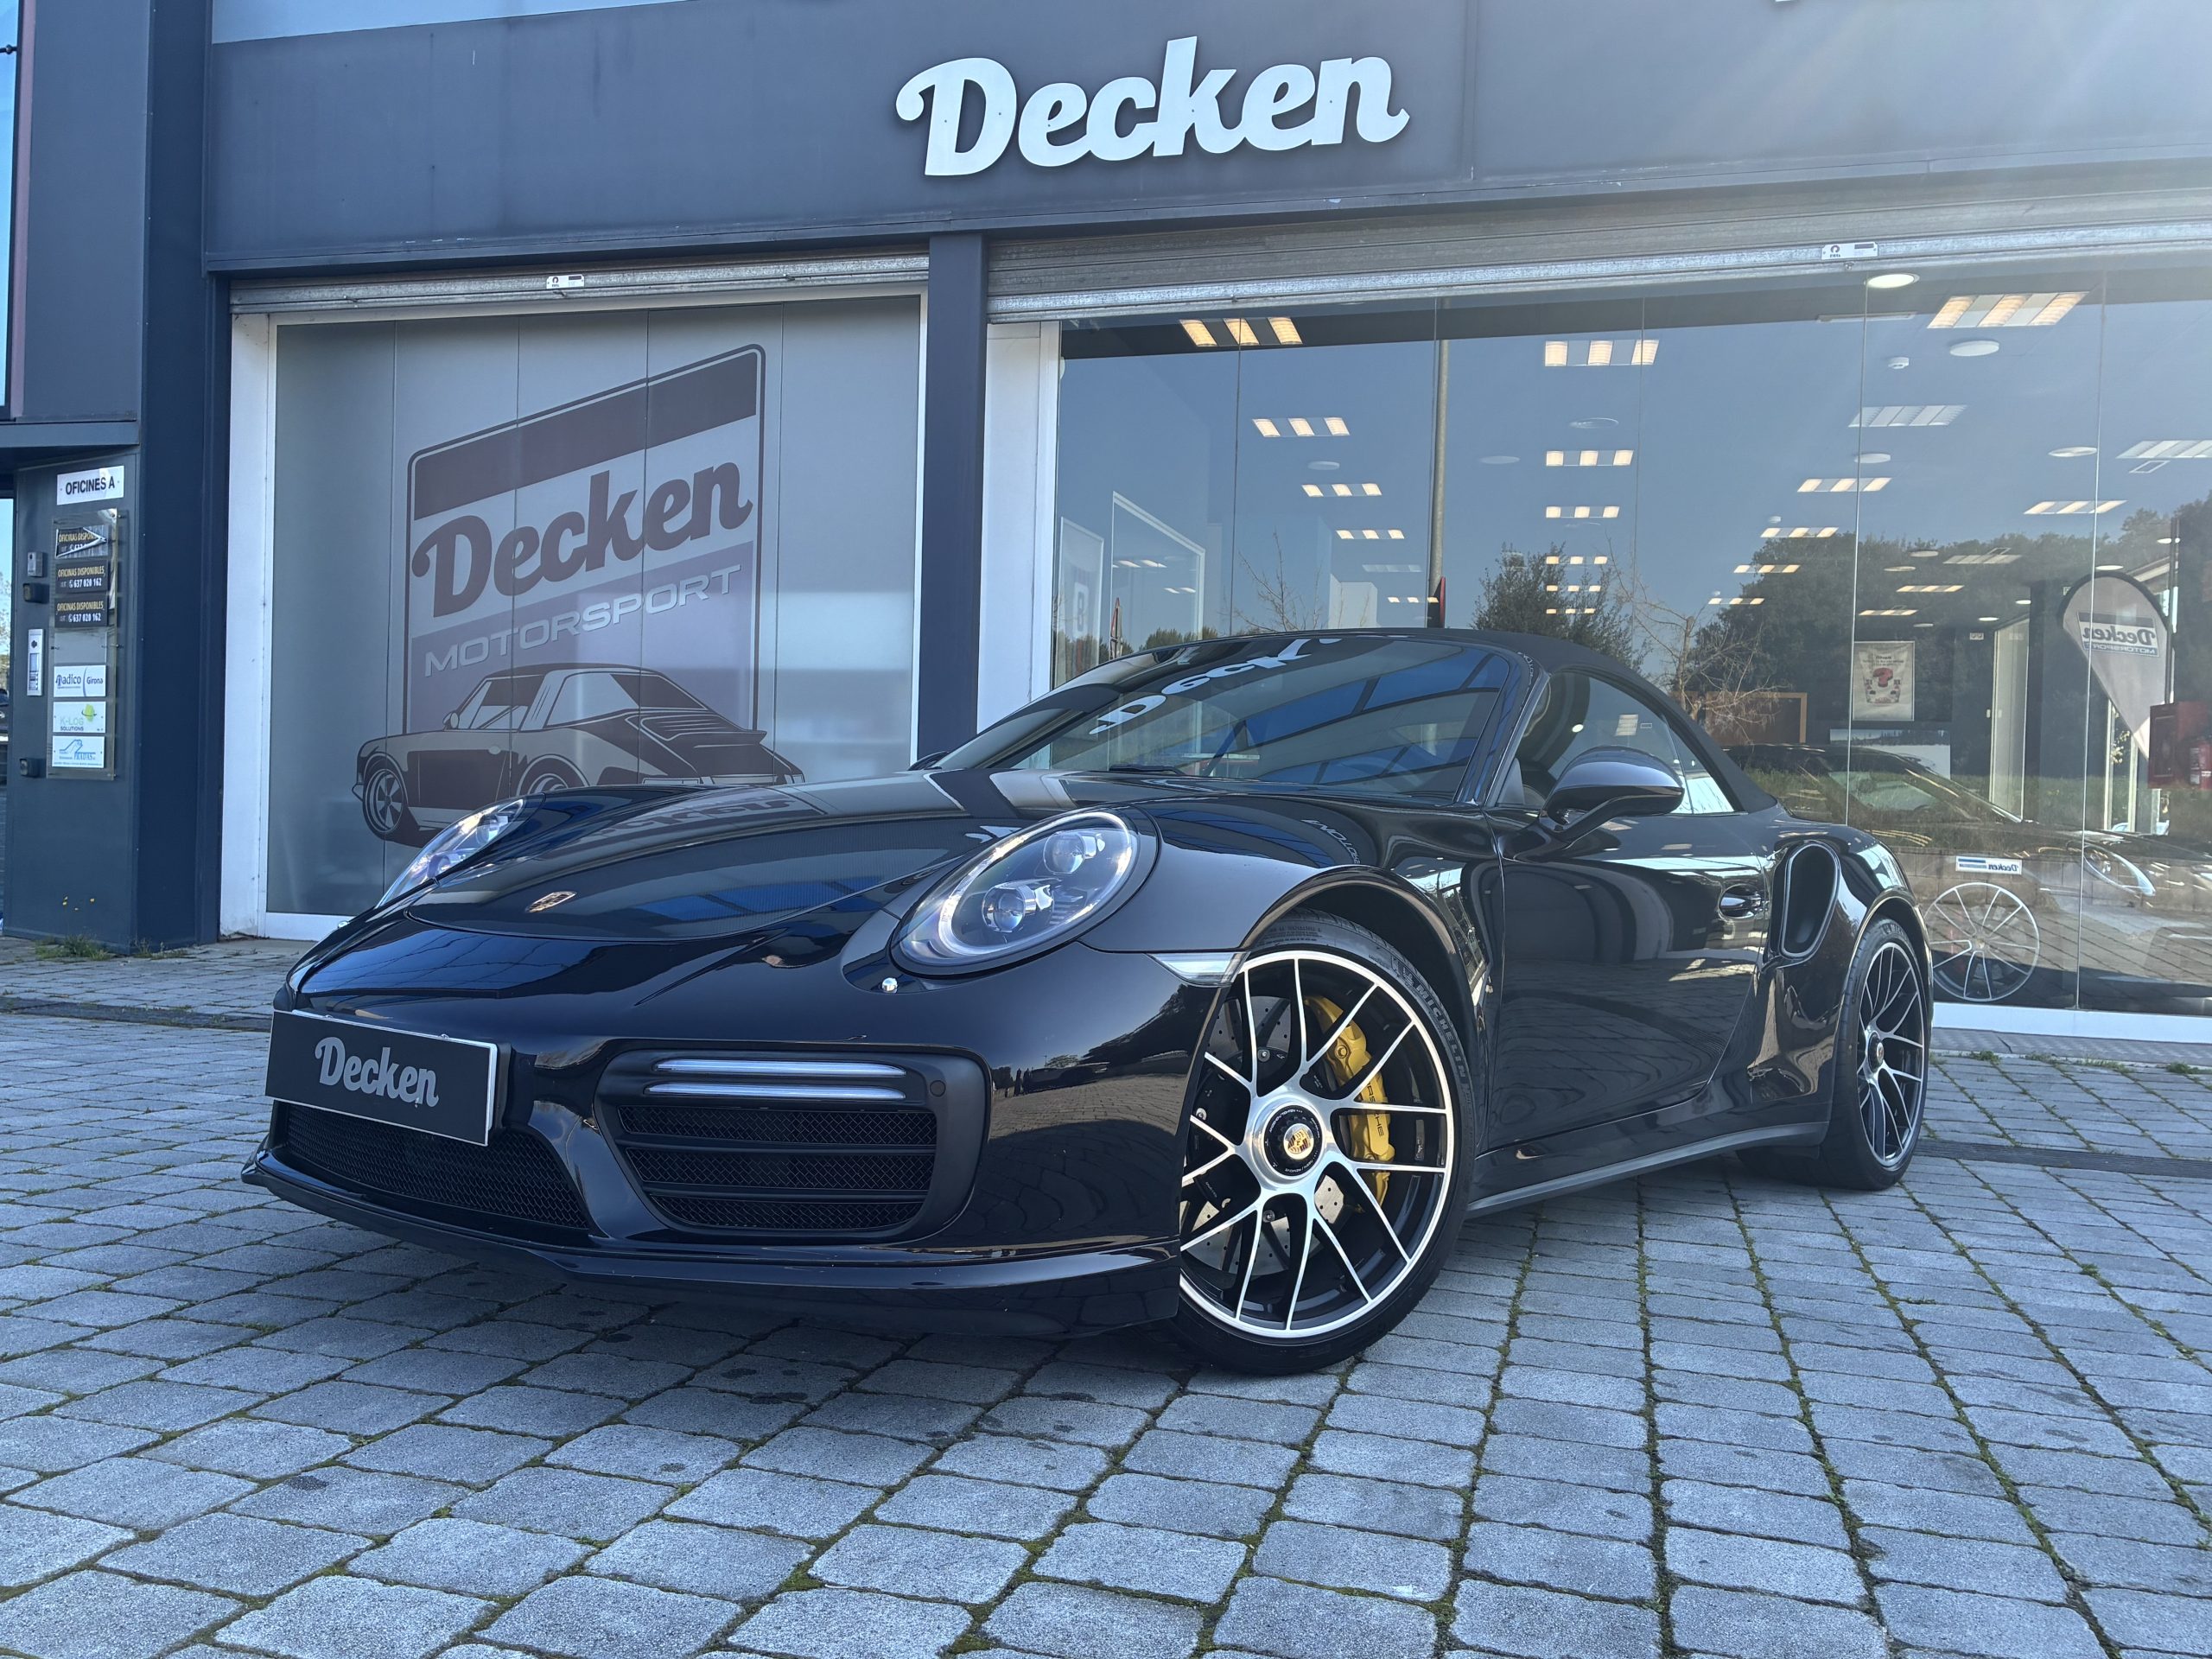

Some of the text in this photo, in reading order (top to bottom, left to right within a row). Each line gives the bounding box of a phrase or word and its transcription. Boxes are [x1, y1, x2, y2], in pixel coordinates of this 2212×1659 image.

[896, 35, 1410, 176] Decken
[65, 475, 116, 495] OFICINES A
[411, 461, 753, 619] Decken
[57, 566, 105, 578] OFICINAS DISPONIBLES
[73, 578, 83, 588] 637
[56, 601, 104, 612] OFICINAS DISPONIBLES
[73, 613, 82, 623] 637
[423, 564, 742, 678] MOTORSPORT
[86, 676, 104, 685] Girona
[1415, 984, 1467, 1078] MICHELIN
[315, 1036, 440, 1109] Decken
